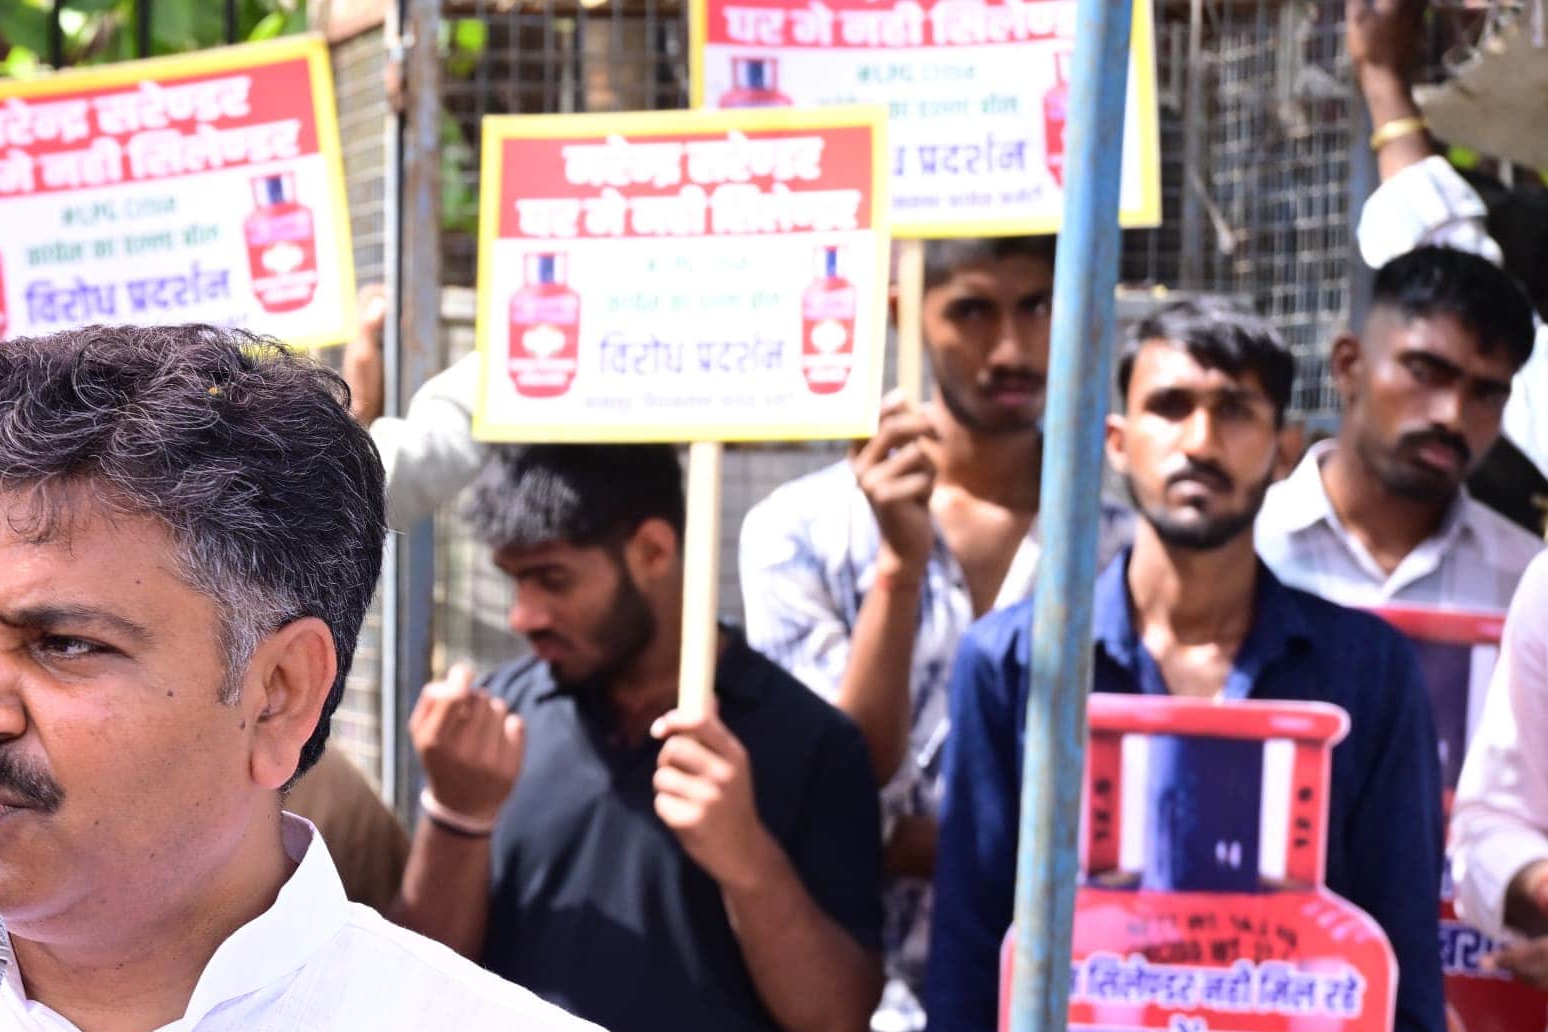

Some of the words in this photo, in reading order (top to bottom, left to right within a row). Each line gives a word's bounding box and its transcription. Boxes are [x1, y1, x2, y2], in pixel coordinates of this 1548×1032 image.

[24, 272, 117, 325] विरोध
[126, 258, 232, 314] प्रदर्शन
[600, 328, 684, 377] विरोध
